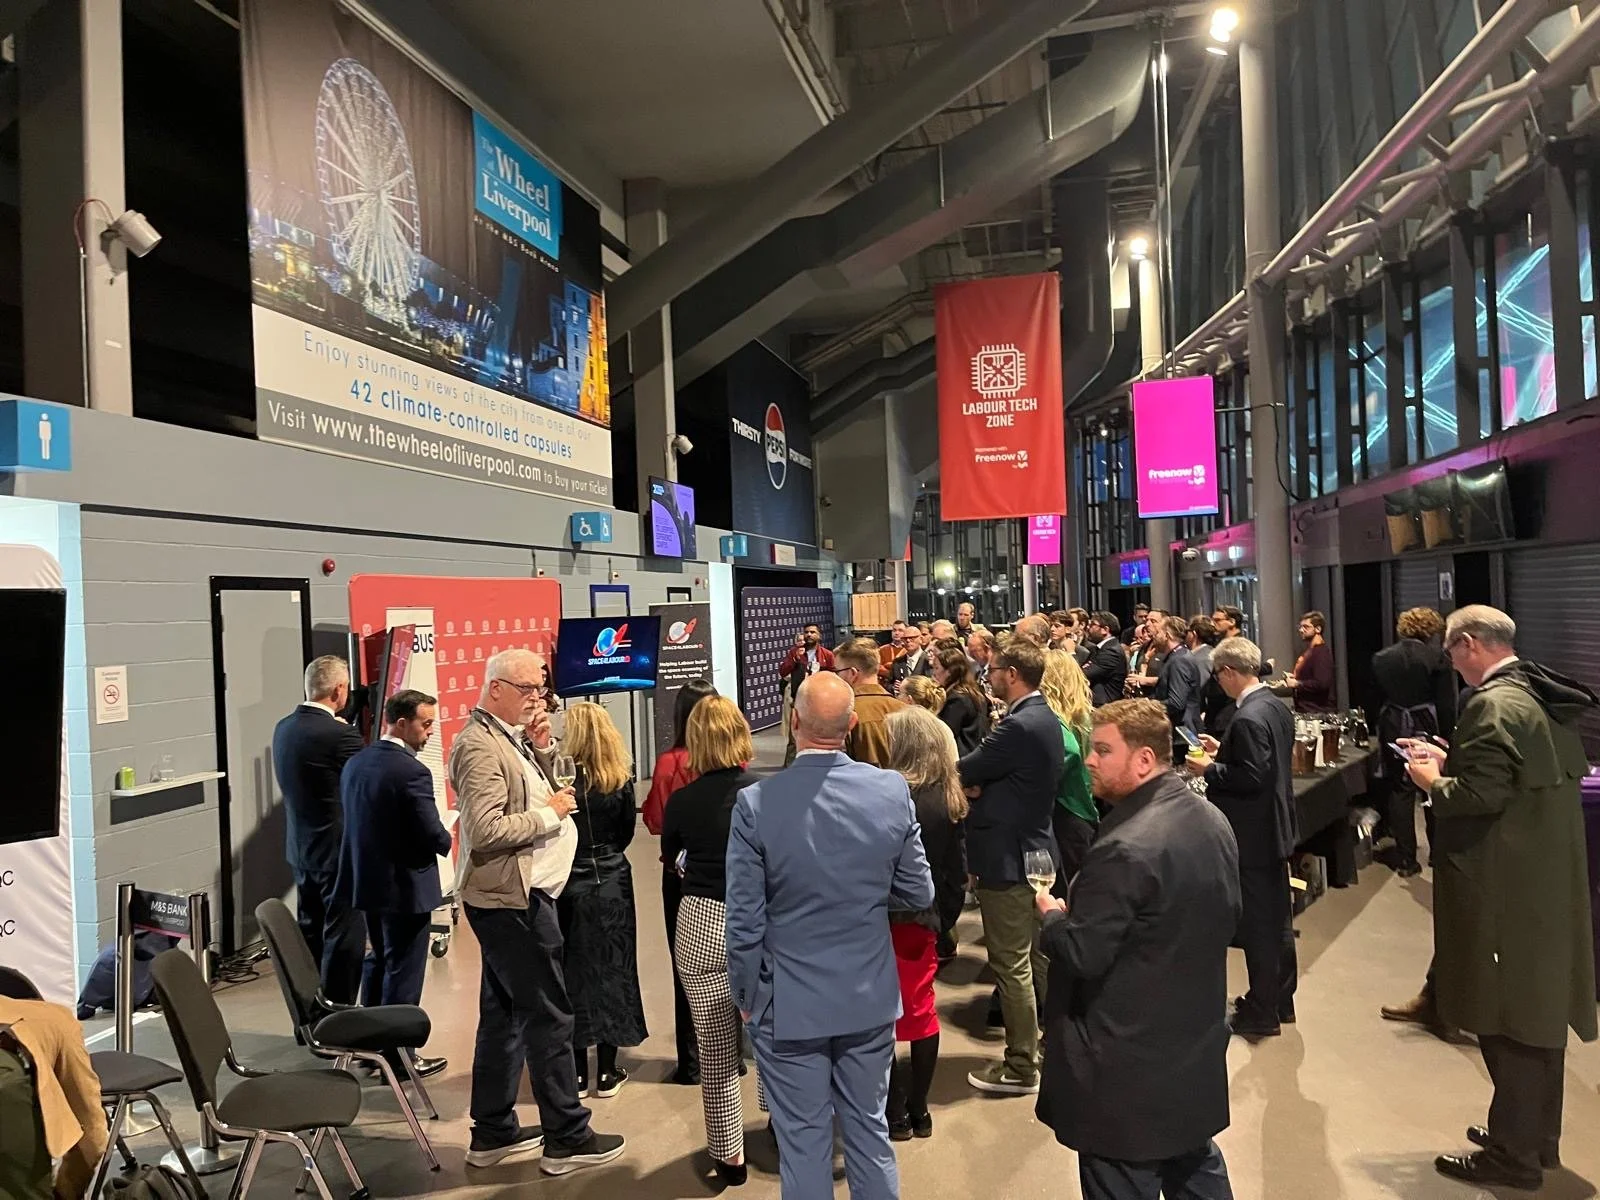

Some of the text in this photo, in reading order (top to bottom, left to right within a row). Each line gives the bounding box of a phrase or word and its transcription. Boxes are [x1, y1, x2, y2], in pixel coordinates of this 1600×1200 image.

[482, 172, 552, 241] Liverpool
[495, 145, 550, 211] Wheel
[304, 330, 350, 369] Enjoy
[358, 350, 418, 391] stunning
[425, 375, 458, 399] views
[463, 386, 475, 403] of
[479, 390, 497, 411] the
[500, 400, 518, 422] city
[521, 404, 546, 427] from
[547, 418, 564, 433] one
[962, 397, 1038, 415] LABOUR TECH
[268, 400, 608, 496] Visit www.thewheelofliverpool.com to buy your ticket
[350, 379, 573, 459] 42 climate-controlled capsules
[985, 413, 1015, 428] ZONE
[975, 453, 1017, 463] Freenow
[150, 900, 188, 917] M&S BANK
